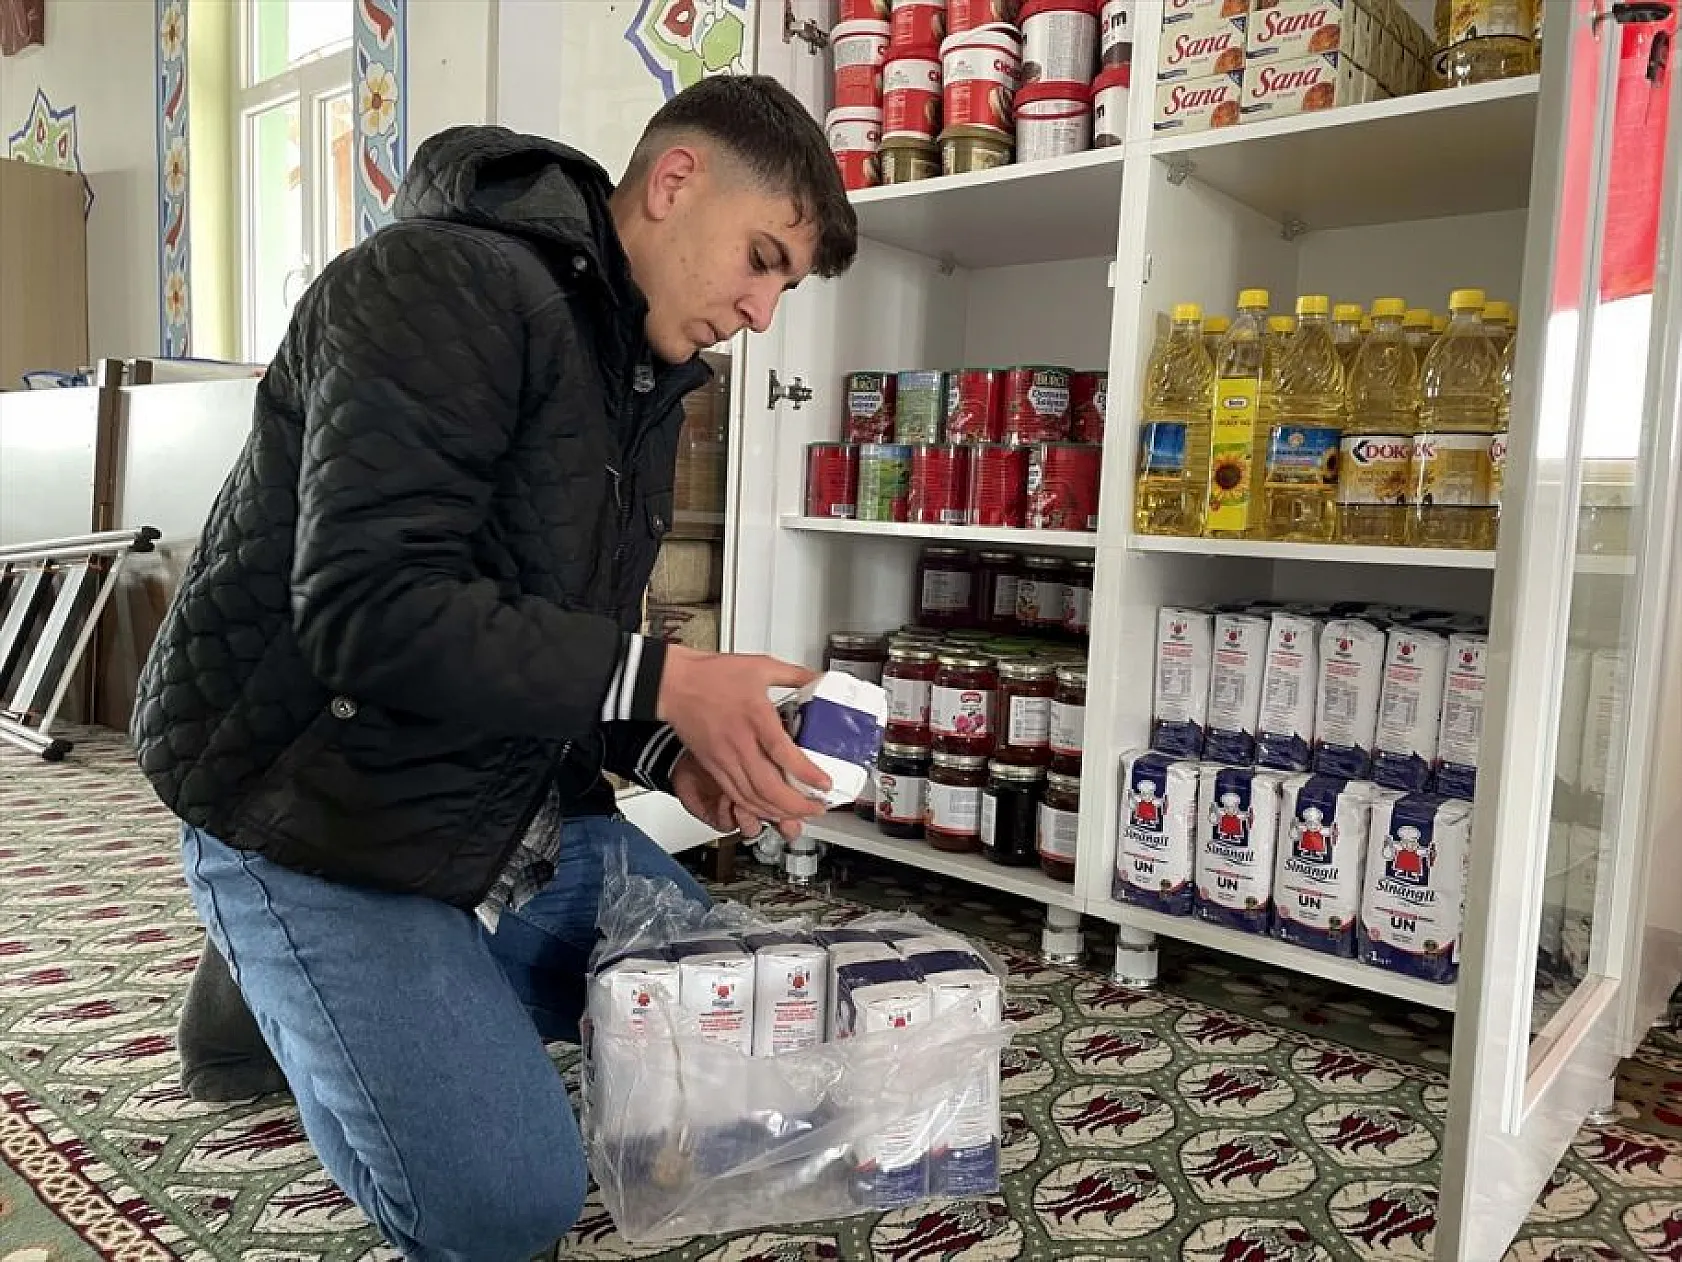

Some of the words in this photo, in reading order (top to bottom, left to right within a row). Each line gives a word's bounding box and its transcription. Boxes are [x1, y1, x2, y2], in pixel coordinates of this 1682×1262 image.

[1257, 9, 1327, 42] Sana
[1167, 33, 1231, 64] Sana
[1251, 66, 1322, 98] Sana
[1164, 86, 1228, 116] Sana
[1134, 859, 1154, 875] UN
[1217, 876, 1238, 892] UN
[1298, 894, 1322, 910] UN
[1390, 916, 1416, 934] UN
